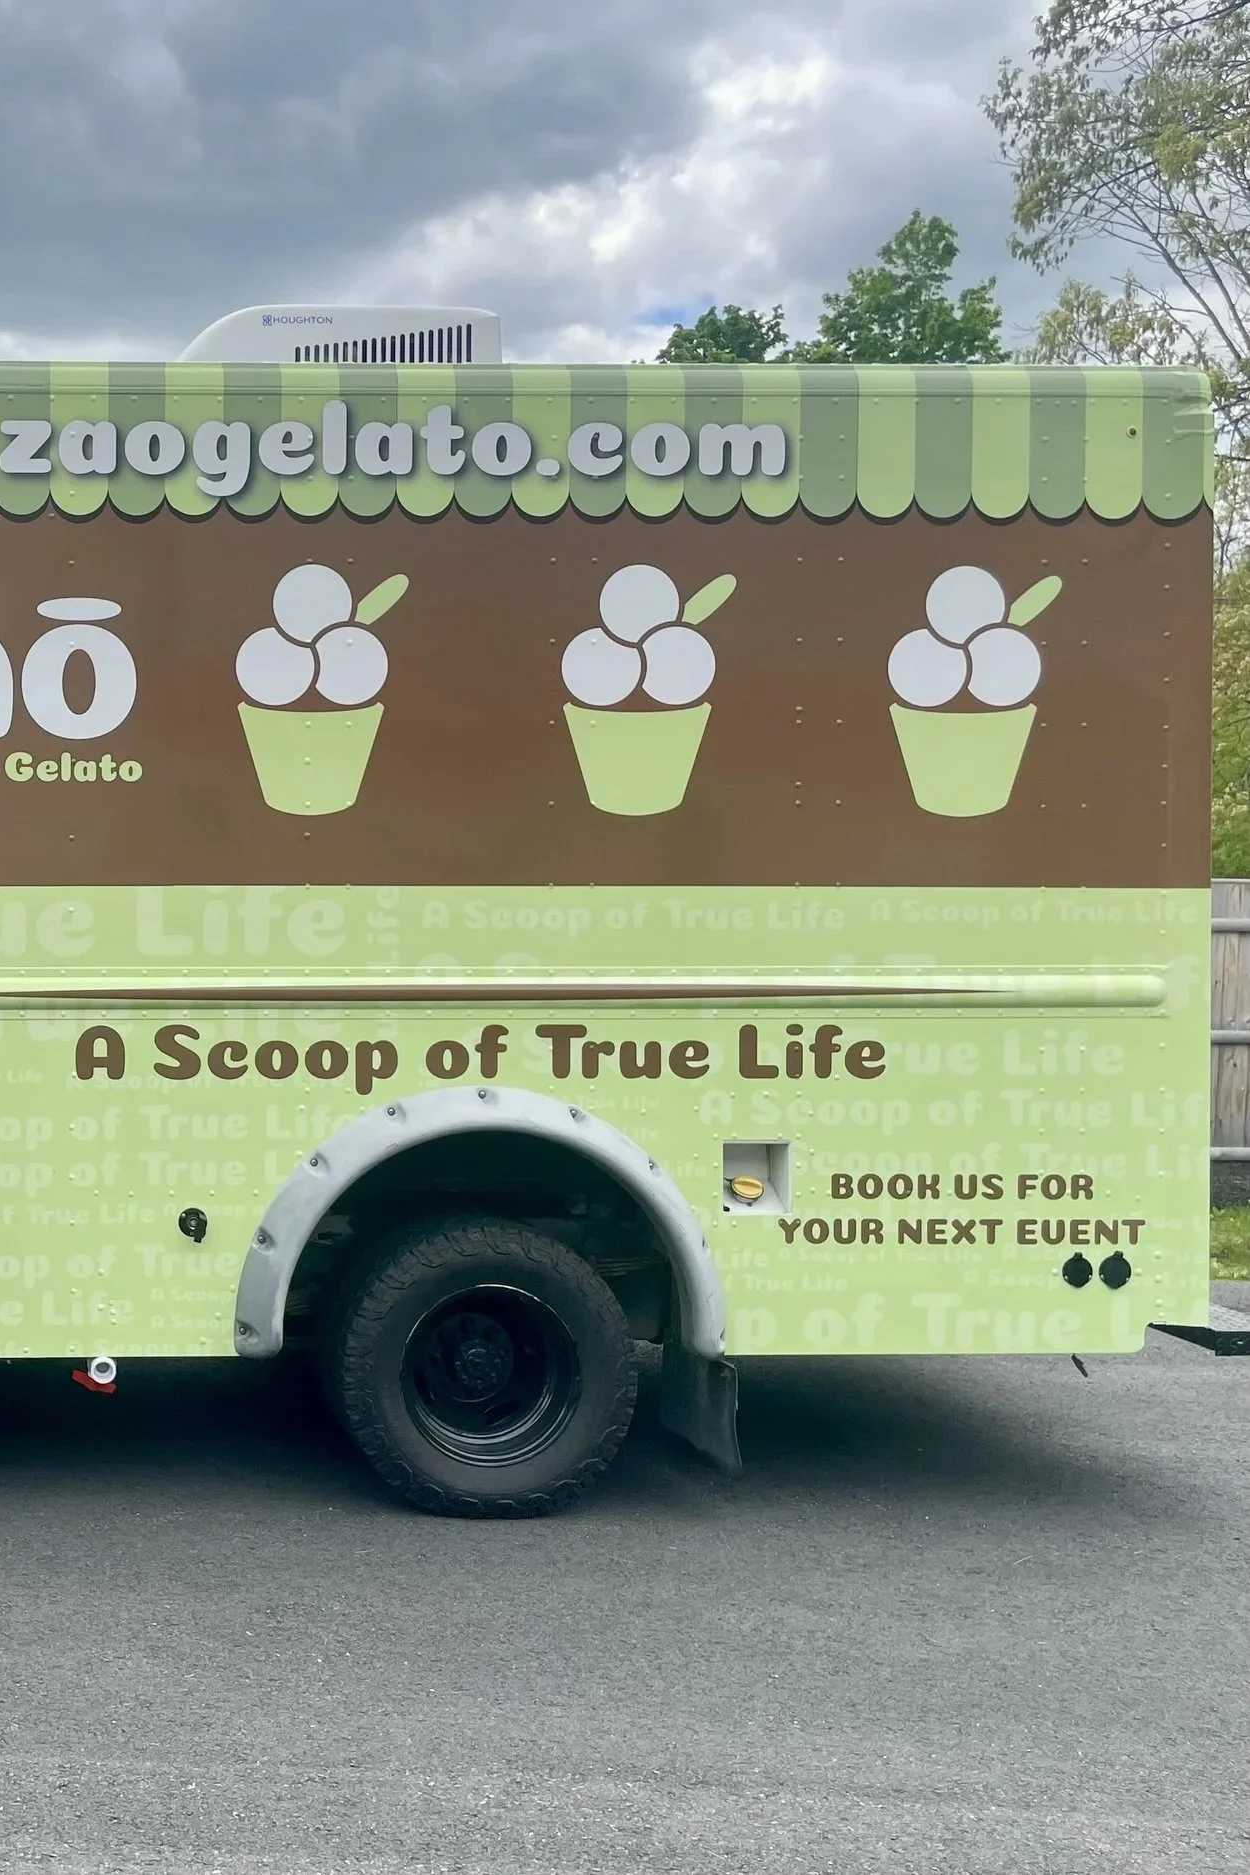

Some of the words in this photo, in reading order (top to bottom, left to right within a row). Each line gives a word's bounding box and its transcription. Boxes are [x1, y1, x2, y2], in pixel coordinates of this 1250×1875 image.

[273, 315, 333, 325] HOUGHTON
[4, 751, 144, 782] Gelato
[135, 887, 348, 957] Life
[422, 899, 450, 930] A
[463, 898, 592, 938] Scoop
[604, 899, 649, 930] of
[662, 899, 754, 930] True
[766, 898, 847, 931] Life
[902, 899, 1000, 929] Scoop
[1058, 899, 1124, 923] True
[76, 1025, 126, 1080] A
[153, 1024, 399, 1095] Scoop
[425, 1023, 509, 1080] of
[535, 1024, 710, 1080] True
[739, 1024, 886, 1080] Life
[1003, 1028, 1125, 1076] Life
[68, 1105, 123, 1141] of
[138, 1104, 248, 1140] True
[699, 1088, 734, 1125] A
[749, 1088, 911, 1136] Scoop
[928, 1089, 983, 1127] of
[1000, 1088, 1113, 1127] True
[68, 1151, 123, 1188] of
[137, 1150, 248, 1187] True
[831, 1173, 941, 1200] BOOK
[953, 1173, 1004, 1200] US
[1016, 1173, 1094, 1200] FOR
[25, 1203, 90, 1226] True
[101, 1203, 155, 1224] Life
[778, 1218, 884, 1245] YOUR
[898, 1218, 1004, 1245] NEXT
[66, 1244, 118, 1281] of
[134, 1244, 239, 1279] True
[41, 1289, 134, 1326] Life
[802, 1293, 885, 1349] of
[911, 1292, 1083, 1350] True
